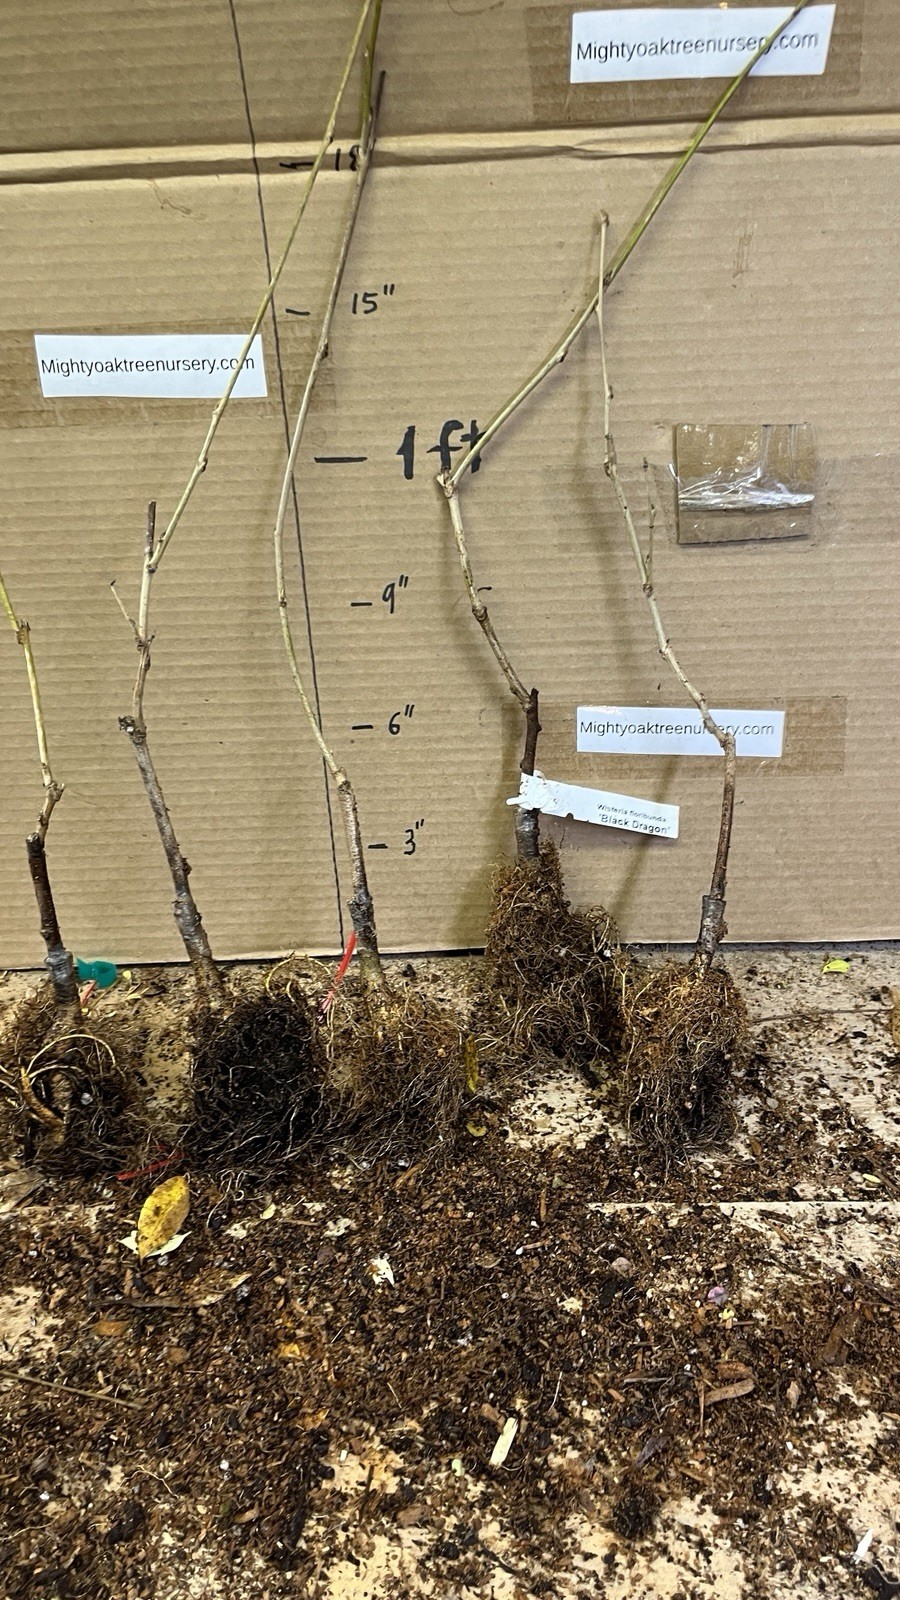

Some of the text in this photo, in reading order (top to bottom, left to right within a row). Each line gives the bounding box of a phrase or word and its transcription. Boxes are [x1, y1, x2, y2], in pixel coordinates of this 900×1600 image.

[352, 284, 395, 314] 15"
[396, 420, 487, 480] 1 ft
[382, 574, 409, 614] 9"
[388, 704, 415, 735] 6"
[580, 721, 774, 737] Mightyoaktreenury.com
[597, 804, 628, 815] Wisteria
[403, 818, 424, 855] 3"
